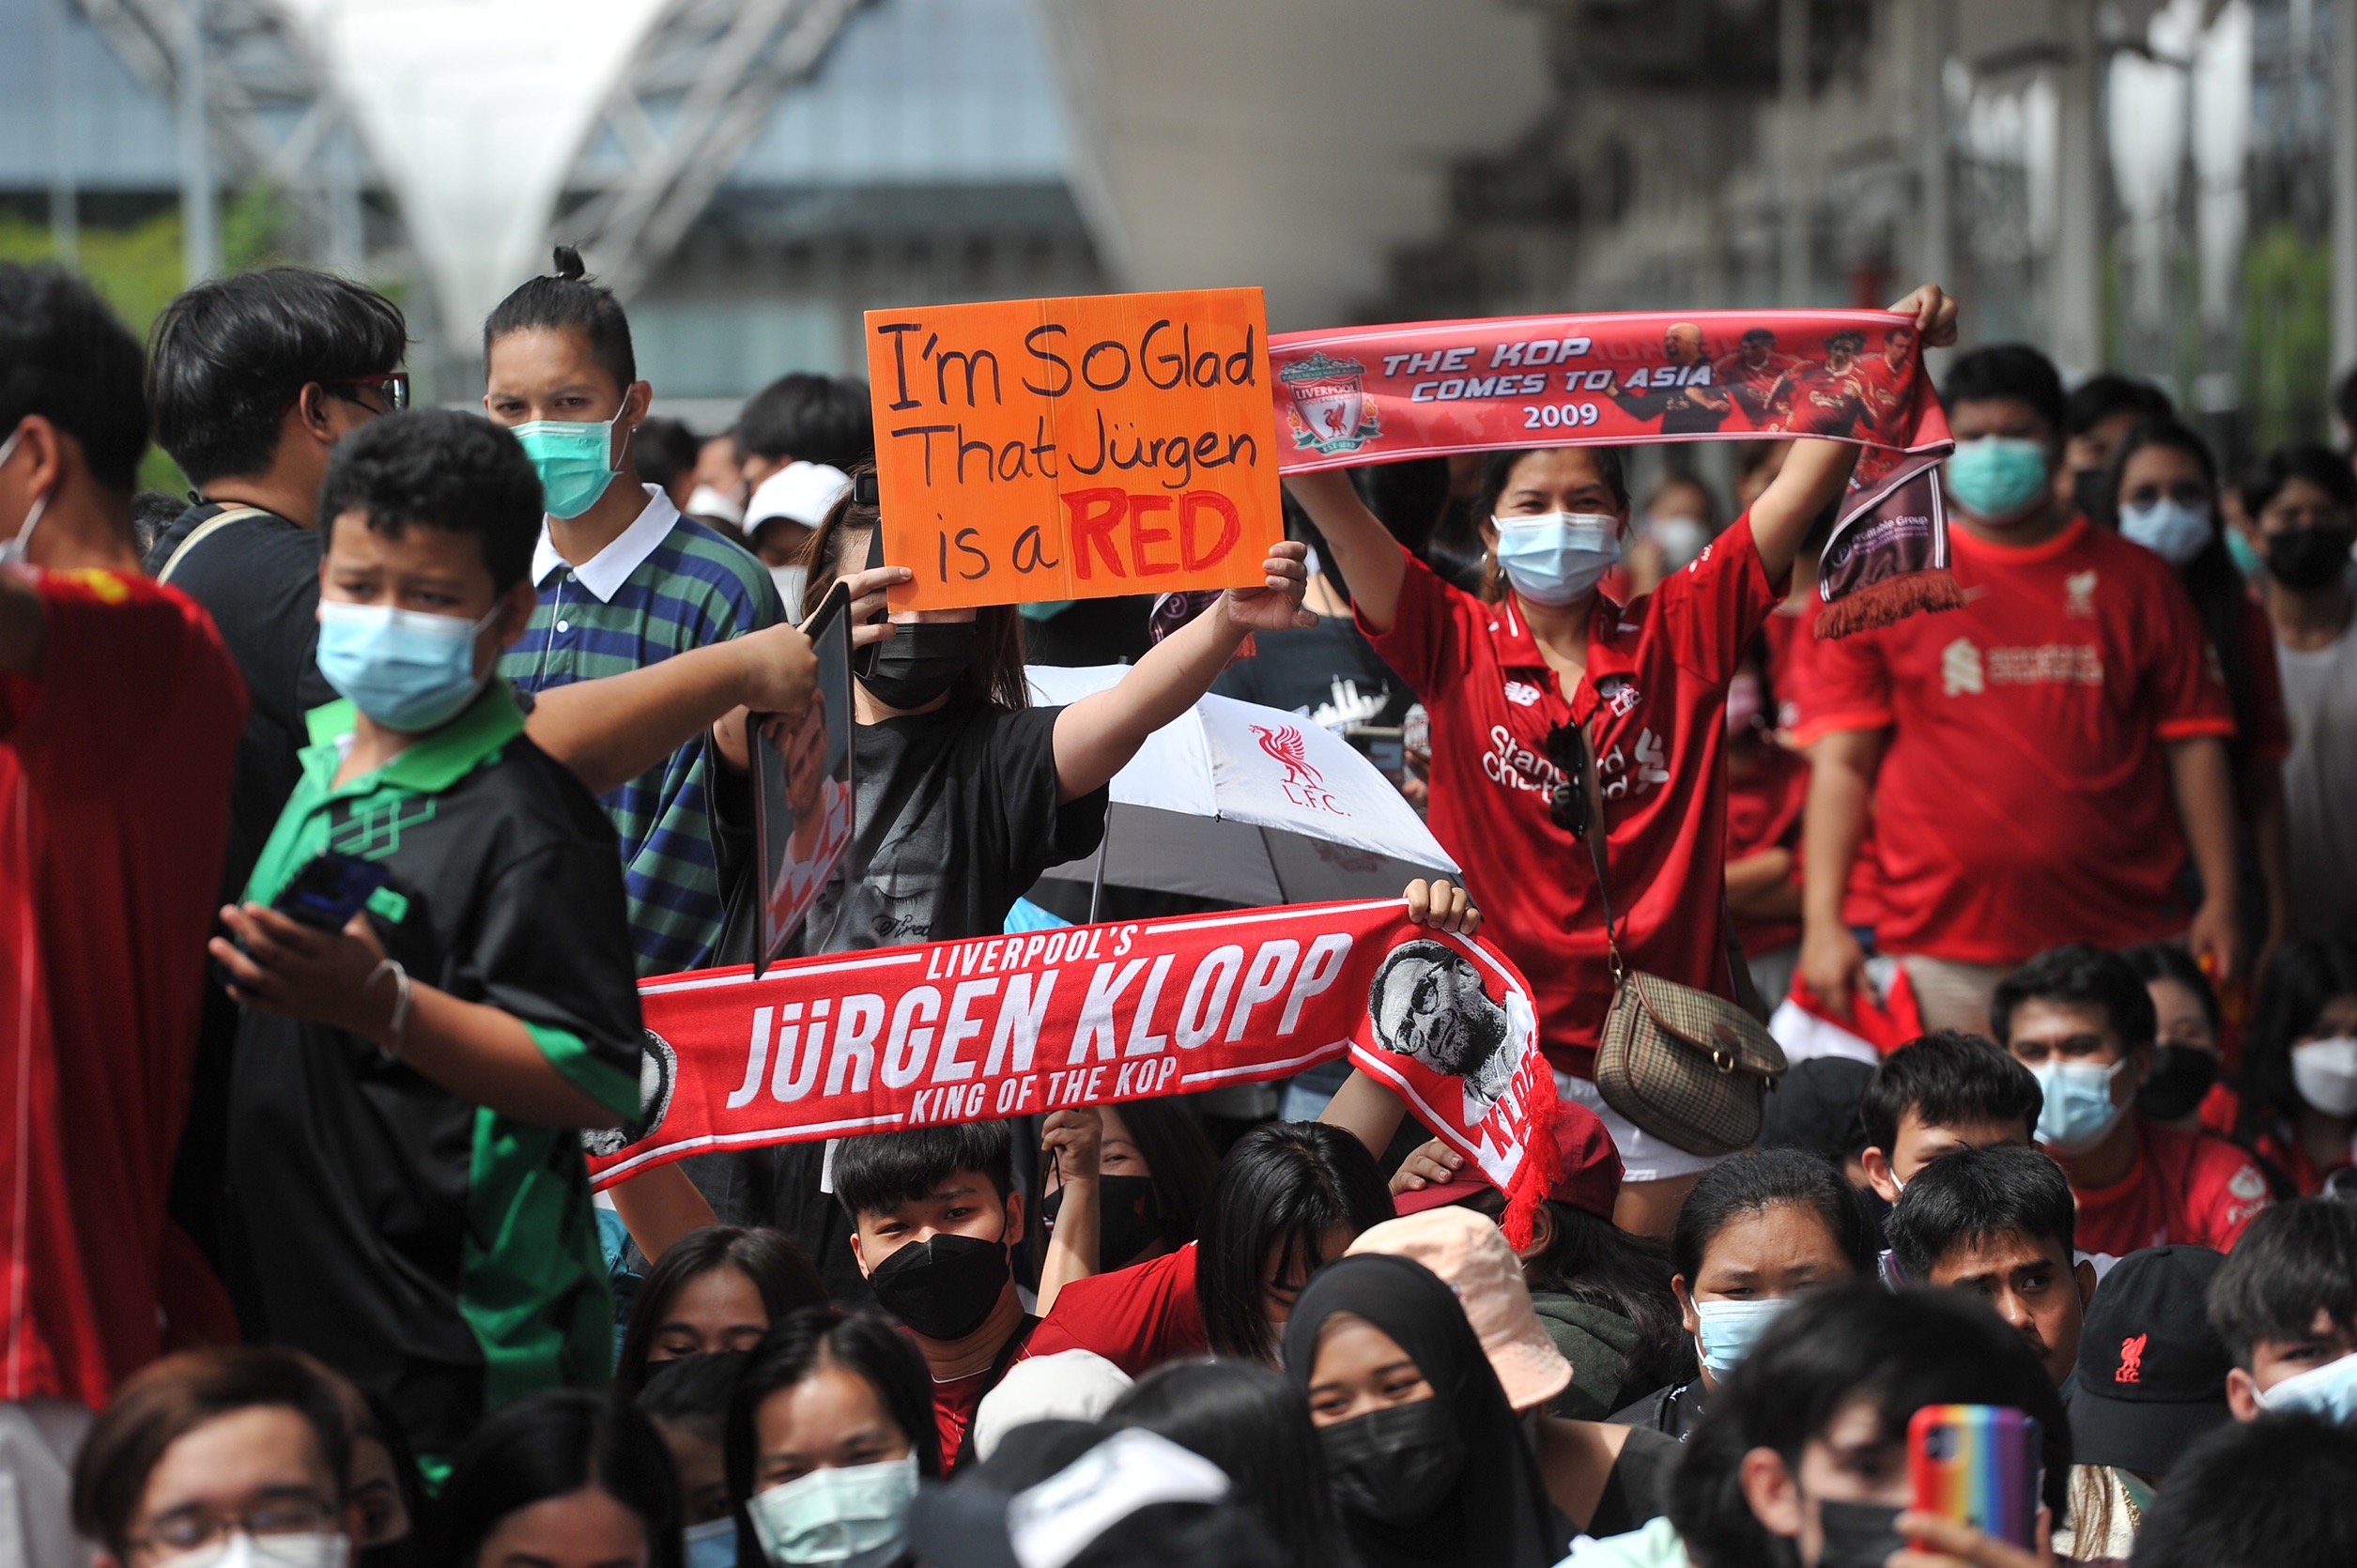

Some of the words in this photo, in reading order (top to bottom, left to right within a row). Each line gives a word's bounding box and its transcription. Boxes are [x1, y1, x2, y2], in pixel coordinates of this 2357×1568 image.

[878, 323, 1001, 411] I'm
[1140, 319, 1255, 390] Glad
[1382, 346, 1477, 377] THE
[1489, 336, 1592, 369] KOP
[1410, 373, 1547, 403] COMES
[1564, 369, 1614, 392] TO
[1625, 364, 1713, 389] ASIA
[1296, 383, 1356, 399] LIVERPOOL
[1522, 402, 1598, 429] 2009
[890, 415, 1059, 487] That
[1068, 408, 1256, 489] Jürgen
[937, 513, 991, 583] is
[1011, 524, 1059, 570] a
[1060, 486, 1242, 580] RED
[1896, 515, 1929, 527] Group
[926, 923, 1139, 981] LIVERPOOL'S
[1066, 932, 1353, 1066] KLOPP
[909, 1083, 989, 1126] KING
[995, 1074, 1038, 1115] OF
[1046, 1065, 1108, 1106] THE
[1114, 1055, 1178, 1099] KOP
[1480, 1030, 1535, 1162] KLOP
